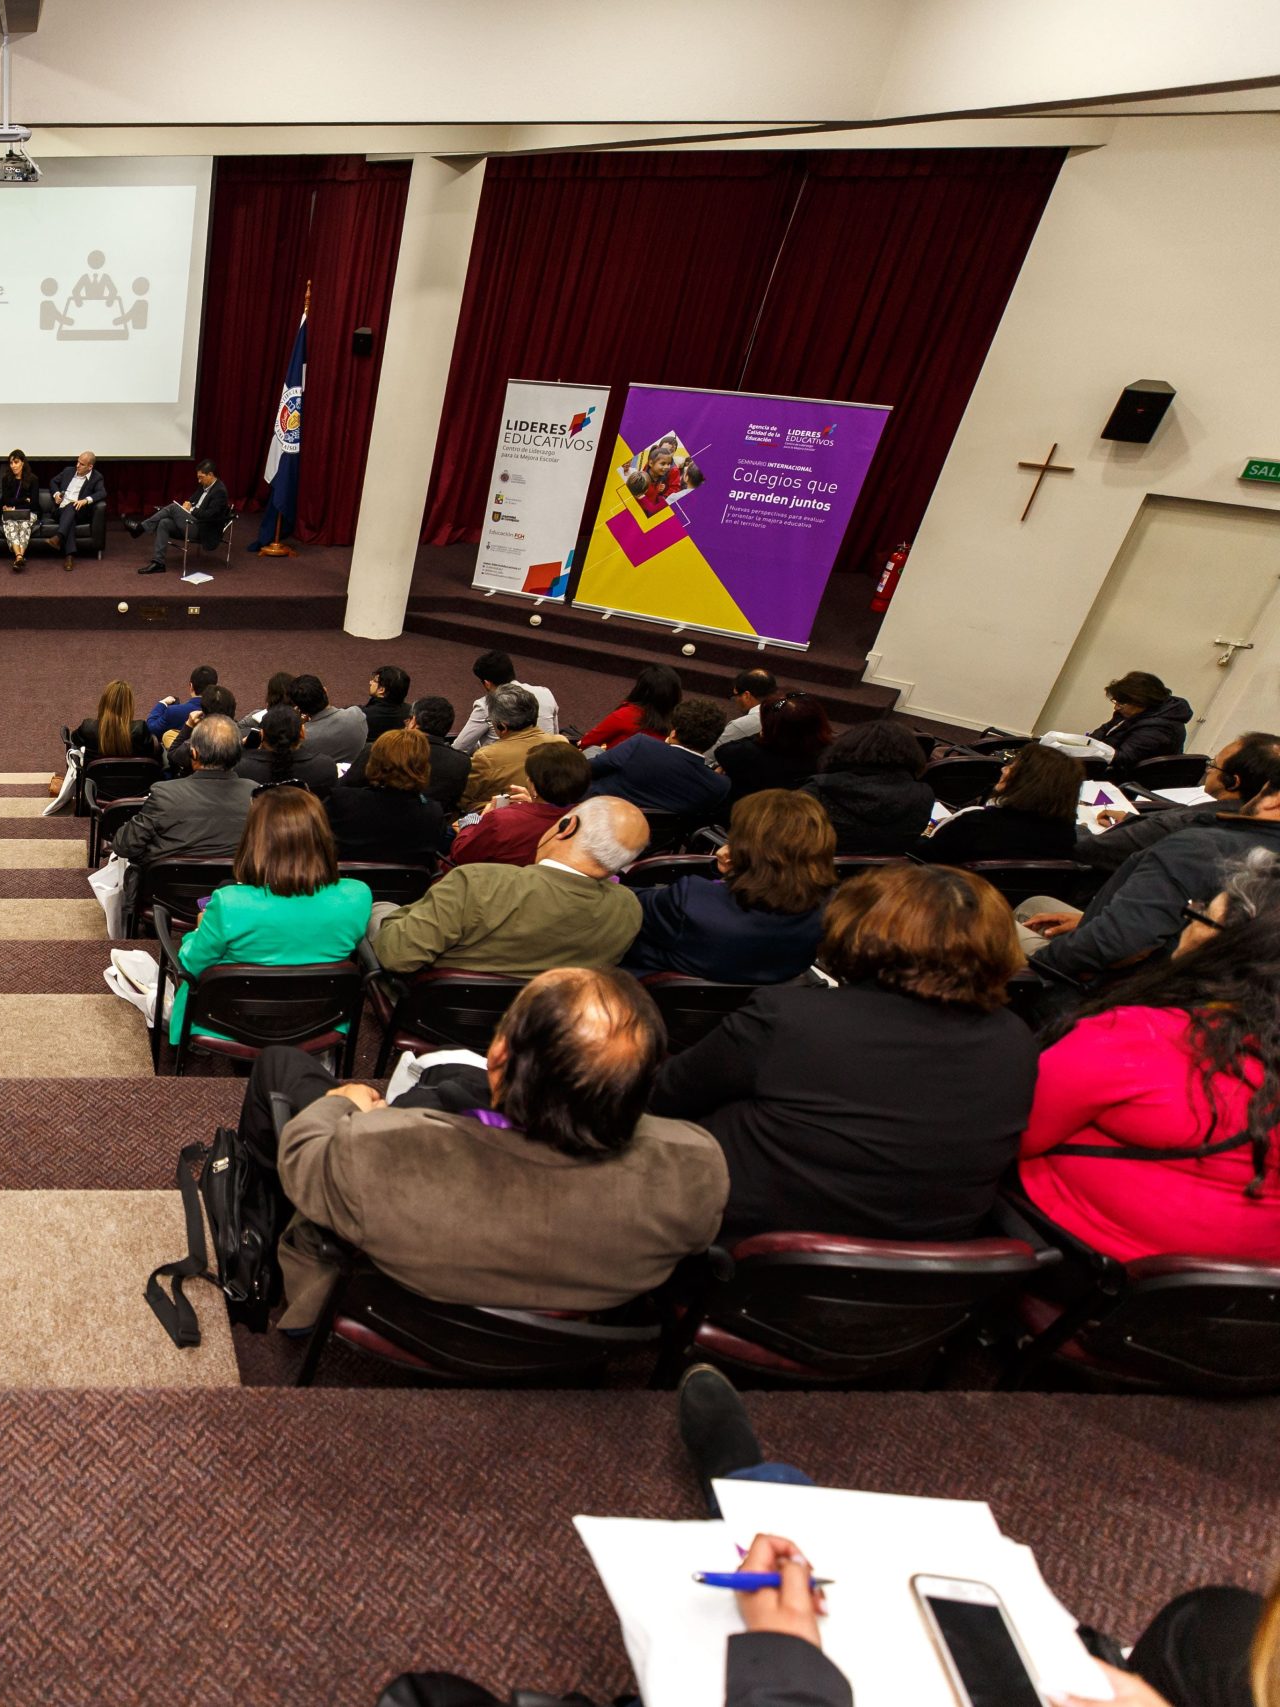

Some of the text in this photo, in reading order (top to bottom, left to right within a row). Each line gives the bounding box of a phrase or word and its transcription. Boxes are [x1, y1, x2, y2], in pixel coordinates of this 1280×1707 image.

[506, 419, 567, 435] LIDERES
[746, 429, 767, 437] Calidad
[745, 435, 772, 443] Educación
[787, 429, 822, 438] LIDERES
[503, 432, 594, 452] EDUCATIVOS
[785, 435, 834, 447] EDUCATIVOS
[502, 445, 521, 453] Centro
[528, 447, 556, 456] Liderazgo
[737, 459, 813, 472] SEMINARIO INTERNACIONAL
[732, 467, 838, 495] Colegios que
[728, 489, 832, 512] aprenden juntos
[729, 505, 825, 524] Nuevas perspectivas para evaluar
[740, 520, 766, 529] territorio
[762, 517, 783, 525] mejora
[783, 519, 813, 529] educativa
